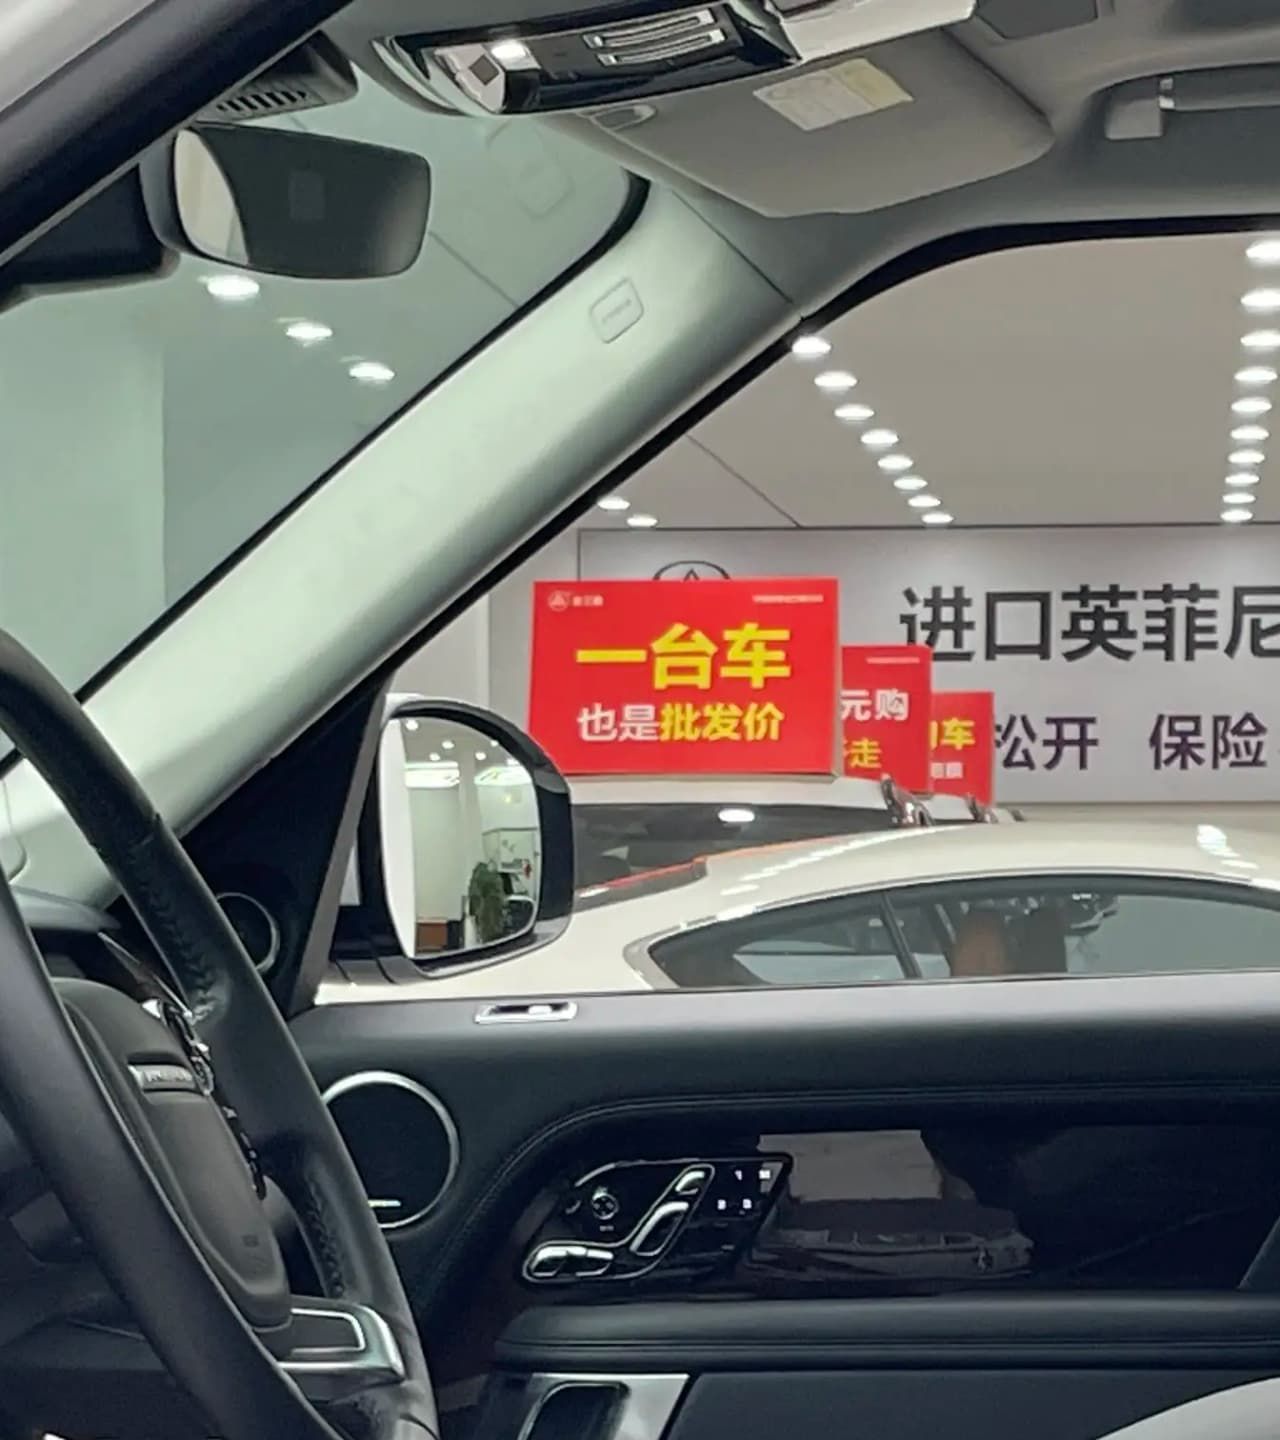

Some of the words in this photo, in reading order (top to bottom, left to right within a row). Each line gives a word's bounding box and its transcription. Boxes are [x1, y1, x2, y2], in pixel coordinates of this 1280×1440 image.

[576, 622, 791, 690] 一台车
[577, 702, 784, 742] 也是批发价
[841, 689, 909, 721] 元购
[841, 737, 882, 769] 走
